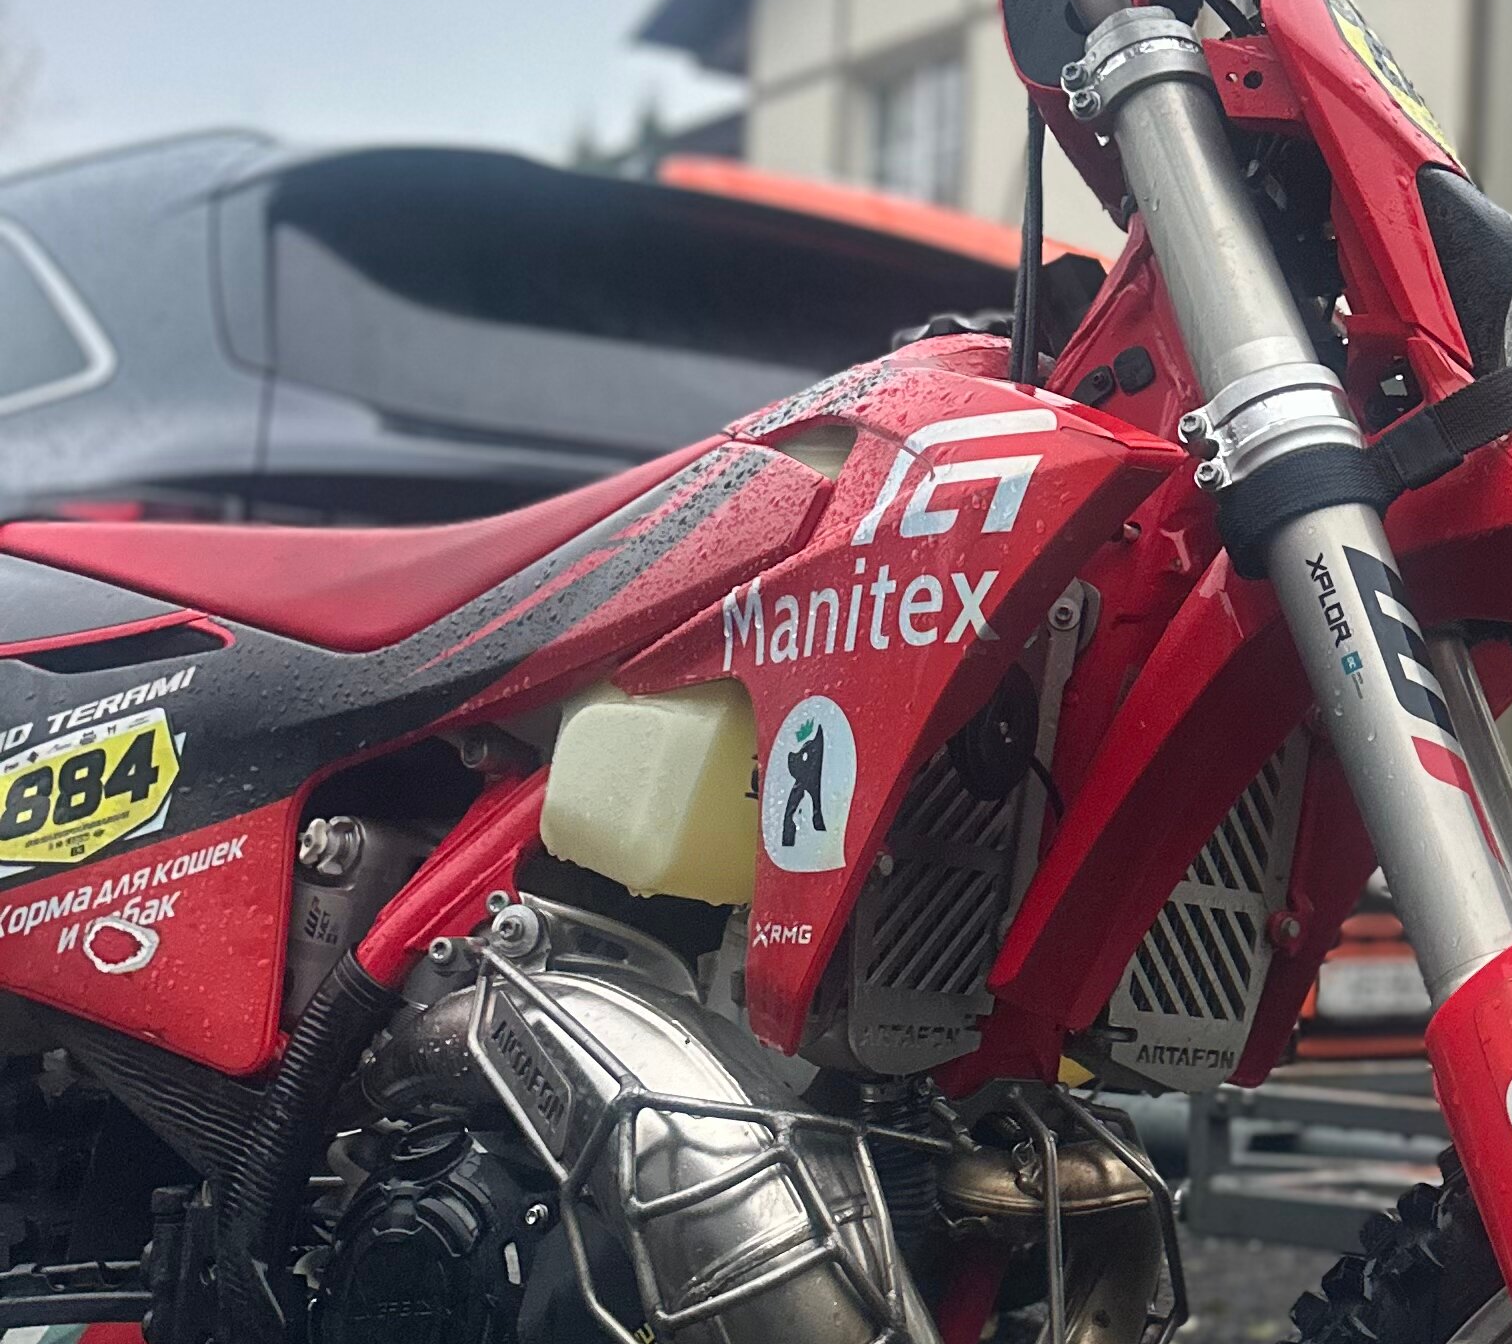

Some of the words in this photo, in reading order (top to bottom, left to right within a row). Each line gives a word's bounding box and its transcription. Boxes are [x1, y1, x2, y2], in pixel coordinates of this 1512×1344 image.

[722, 558, 1000, 672] Manitex
[1306, 553, 1352, 648] XPLOR
[47, 666, 196, 734] TERAMI
[0, 729, 160, 841] 884
[92, 867, 151, 908] для
[152, 834, 248, 887] кошек
[86, 891, 181, 936] бак
[1136, 1044, 1235, 1069] ARTAFON
